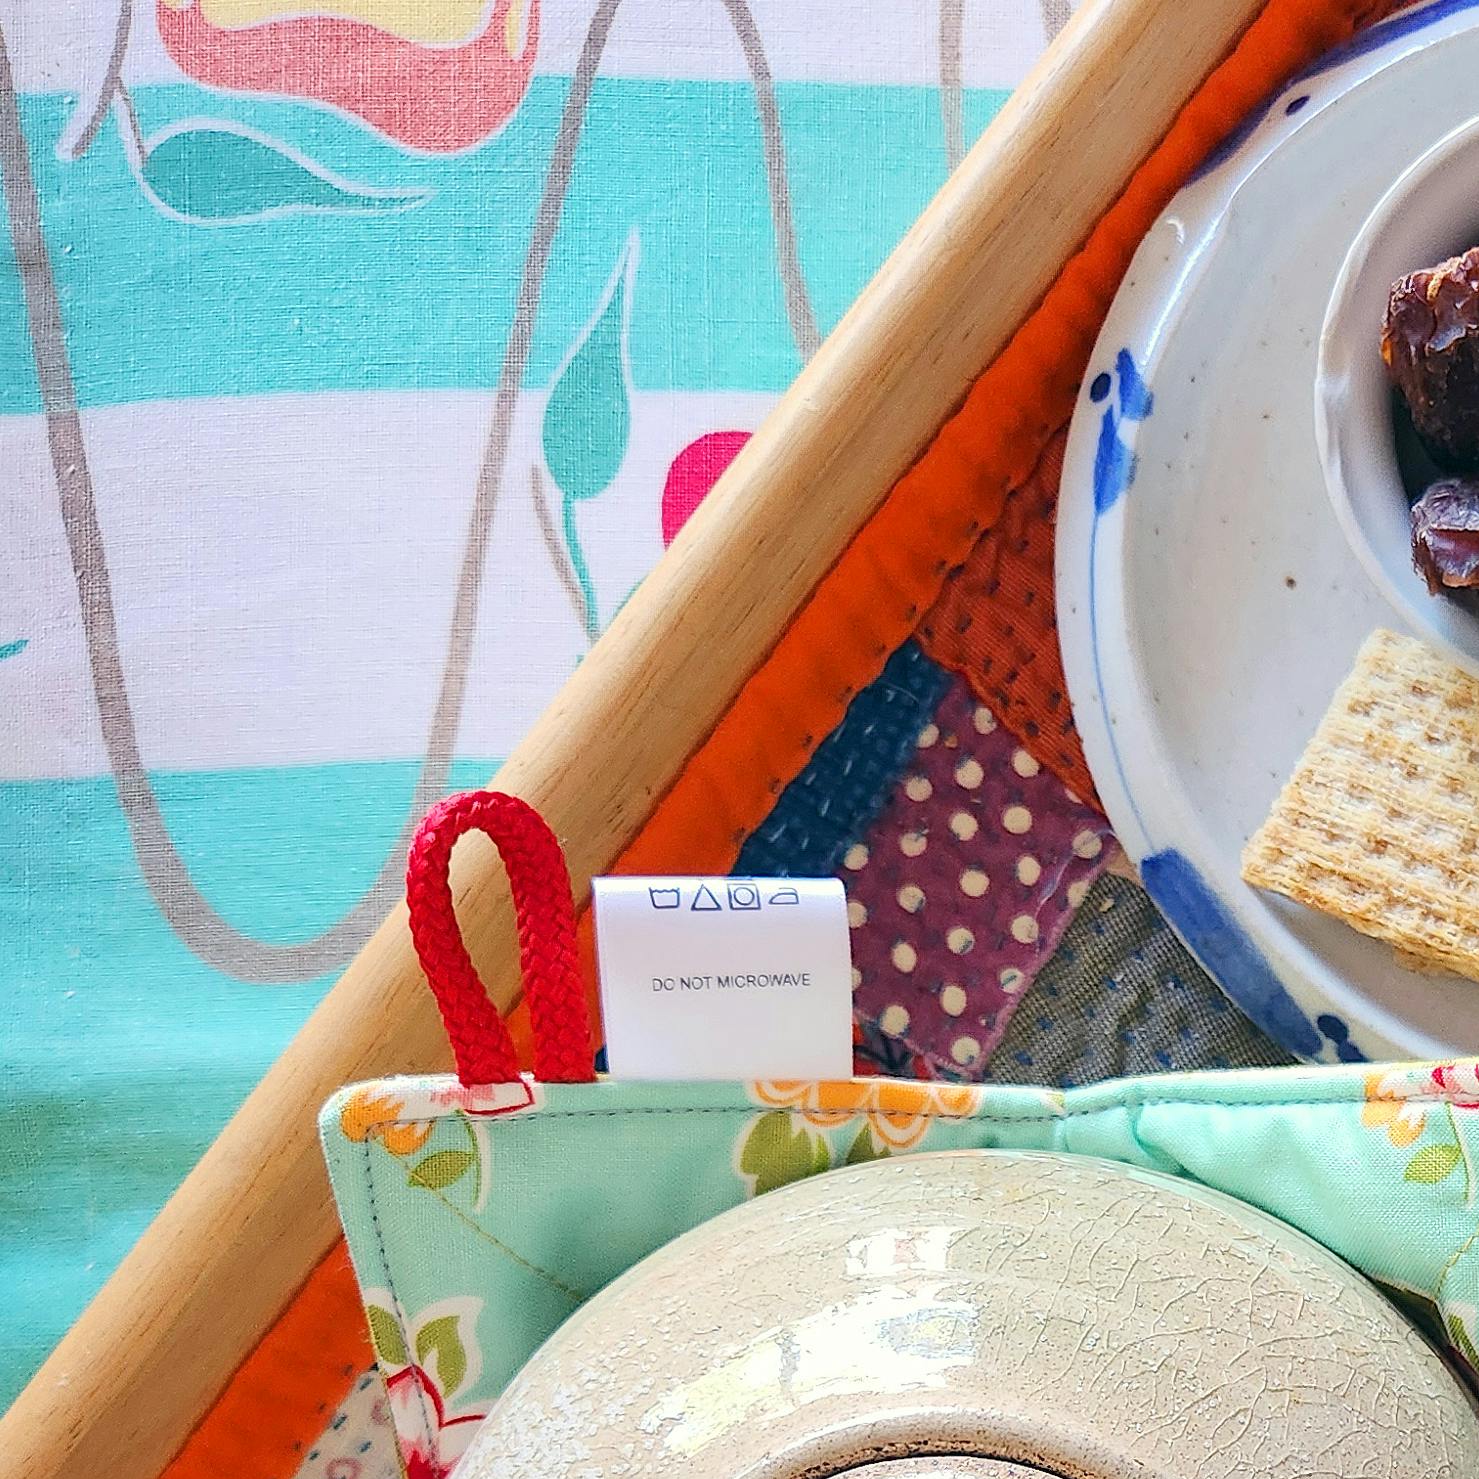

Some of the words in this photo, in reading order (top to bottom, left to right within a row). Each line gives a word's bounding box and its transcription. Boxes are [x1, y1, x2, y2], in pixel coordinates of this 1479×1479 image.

[652, 977, 675, 992] DO
[681, 975, 712, 991] NOT
[717, 973, 811, 989] MICROWAVE
